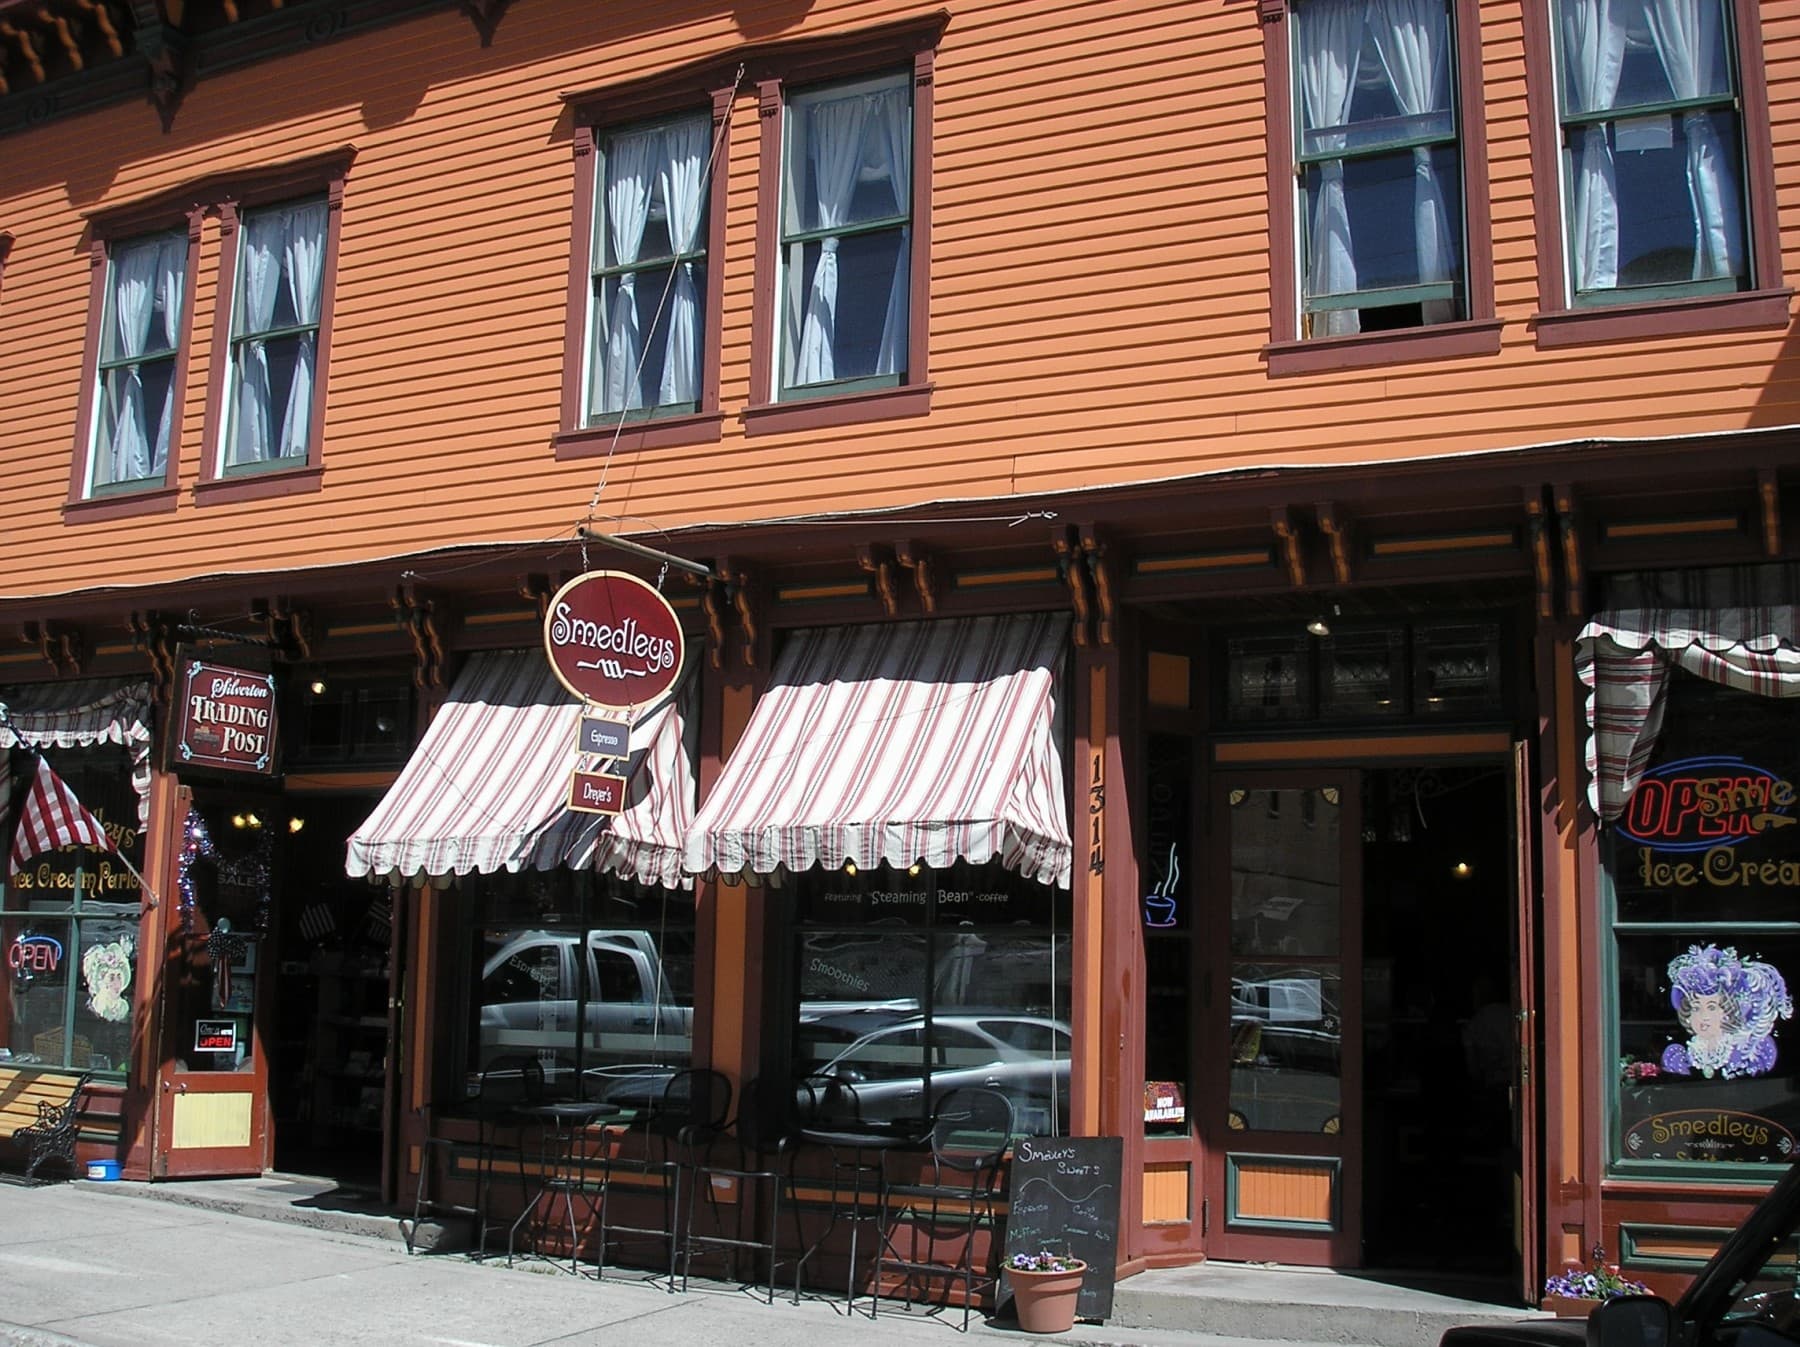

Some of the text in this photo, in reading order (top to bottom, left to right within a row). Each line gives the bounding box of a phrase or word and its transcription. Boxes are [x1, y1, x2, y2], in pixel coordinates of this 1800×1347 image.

[552, 602, 674, 673] Smedleys
[211, 677, 269, 698] Silverton
[190, 695, 269, 729] TRADING
[220, 726, 266, 754] POST
[590, 729, 619, 746] Espresso
[583, 782, 612, 805] Dreyer's
[1088, 754, 1105, 877] 1314
[1638, 847, 1699, 888] Ice
[9, 943, 58, 971] OPEN
[810, 957, 870, 993] Smoothies
[199, 1036, 233, 1047] OPEN
[1651, 1114, 1769, 1146] Smedleys
